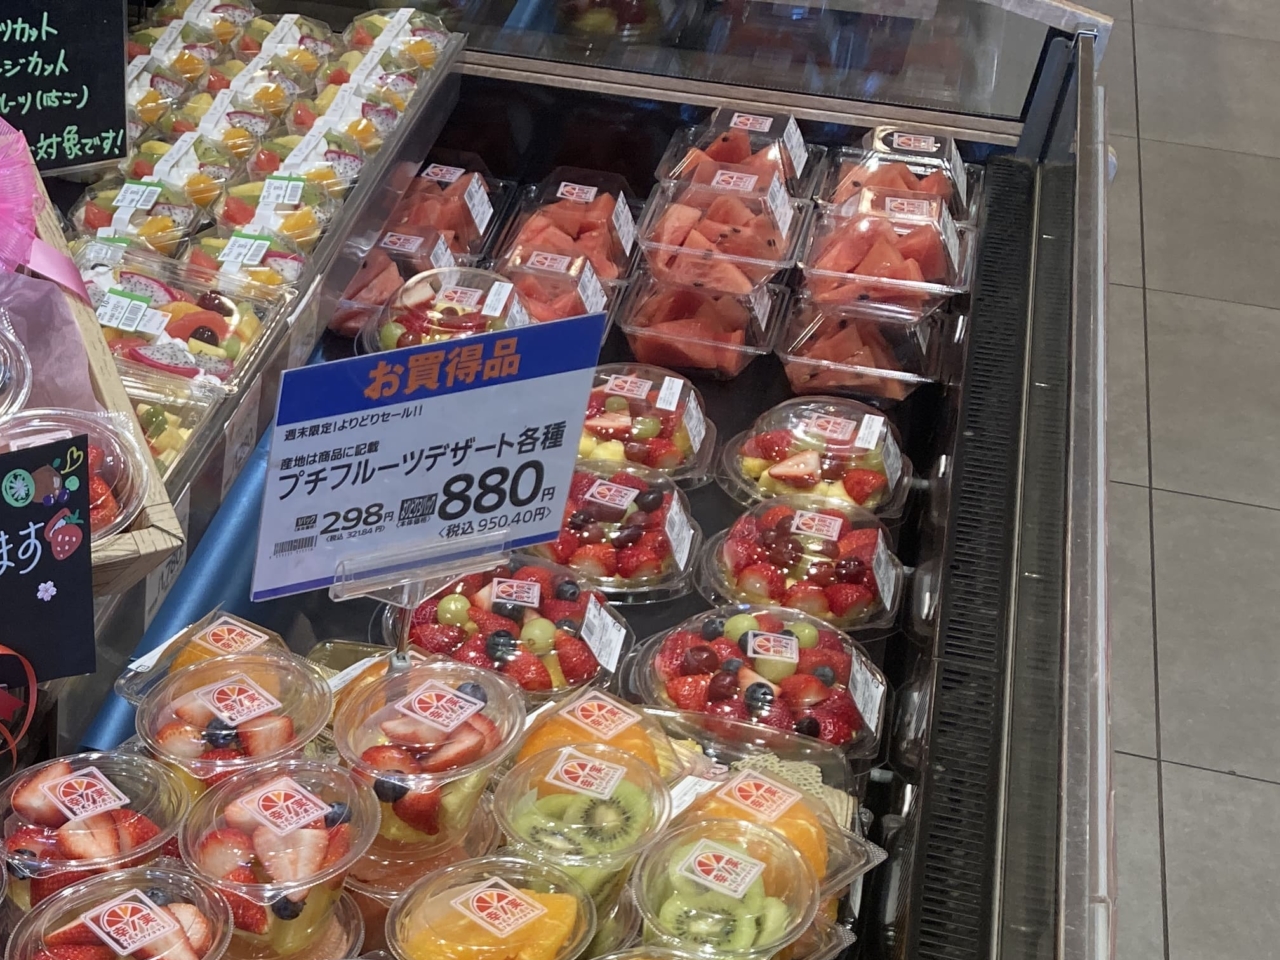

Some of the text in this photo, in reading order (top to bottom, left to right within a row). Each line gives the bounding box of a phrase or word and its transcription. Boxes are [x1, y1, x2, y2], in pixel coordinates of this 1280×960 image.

[363, 337, 521, 400] お買得品
[279, 420, 567, 500] プチフルーツデザート各種
[280, 440, 379, 470] 産地は商品に記載
